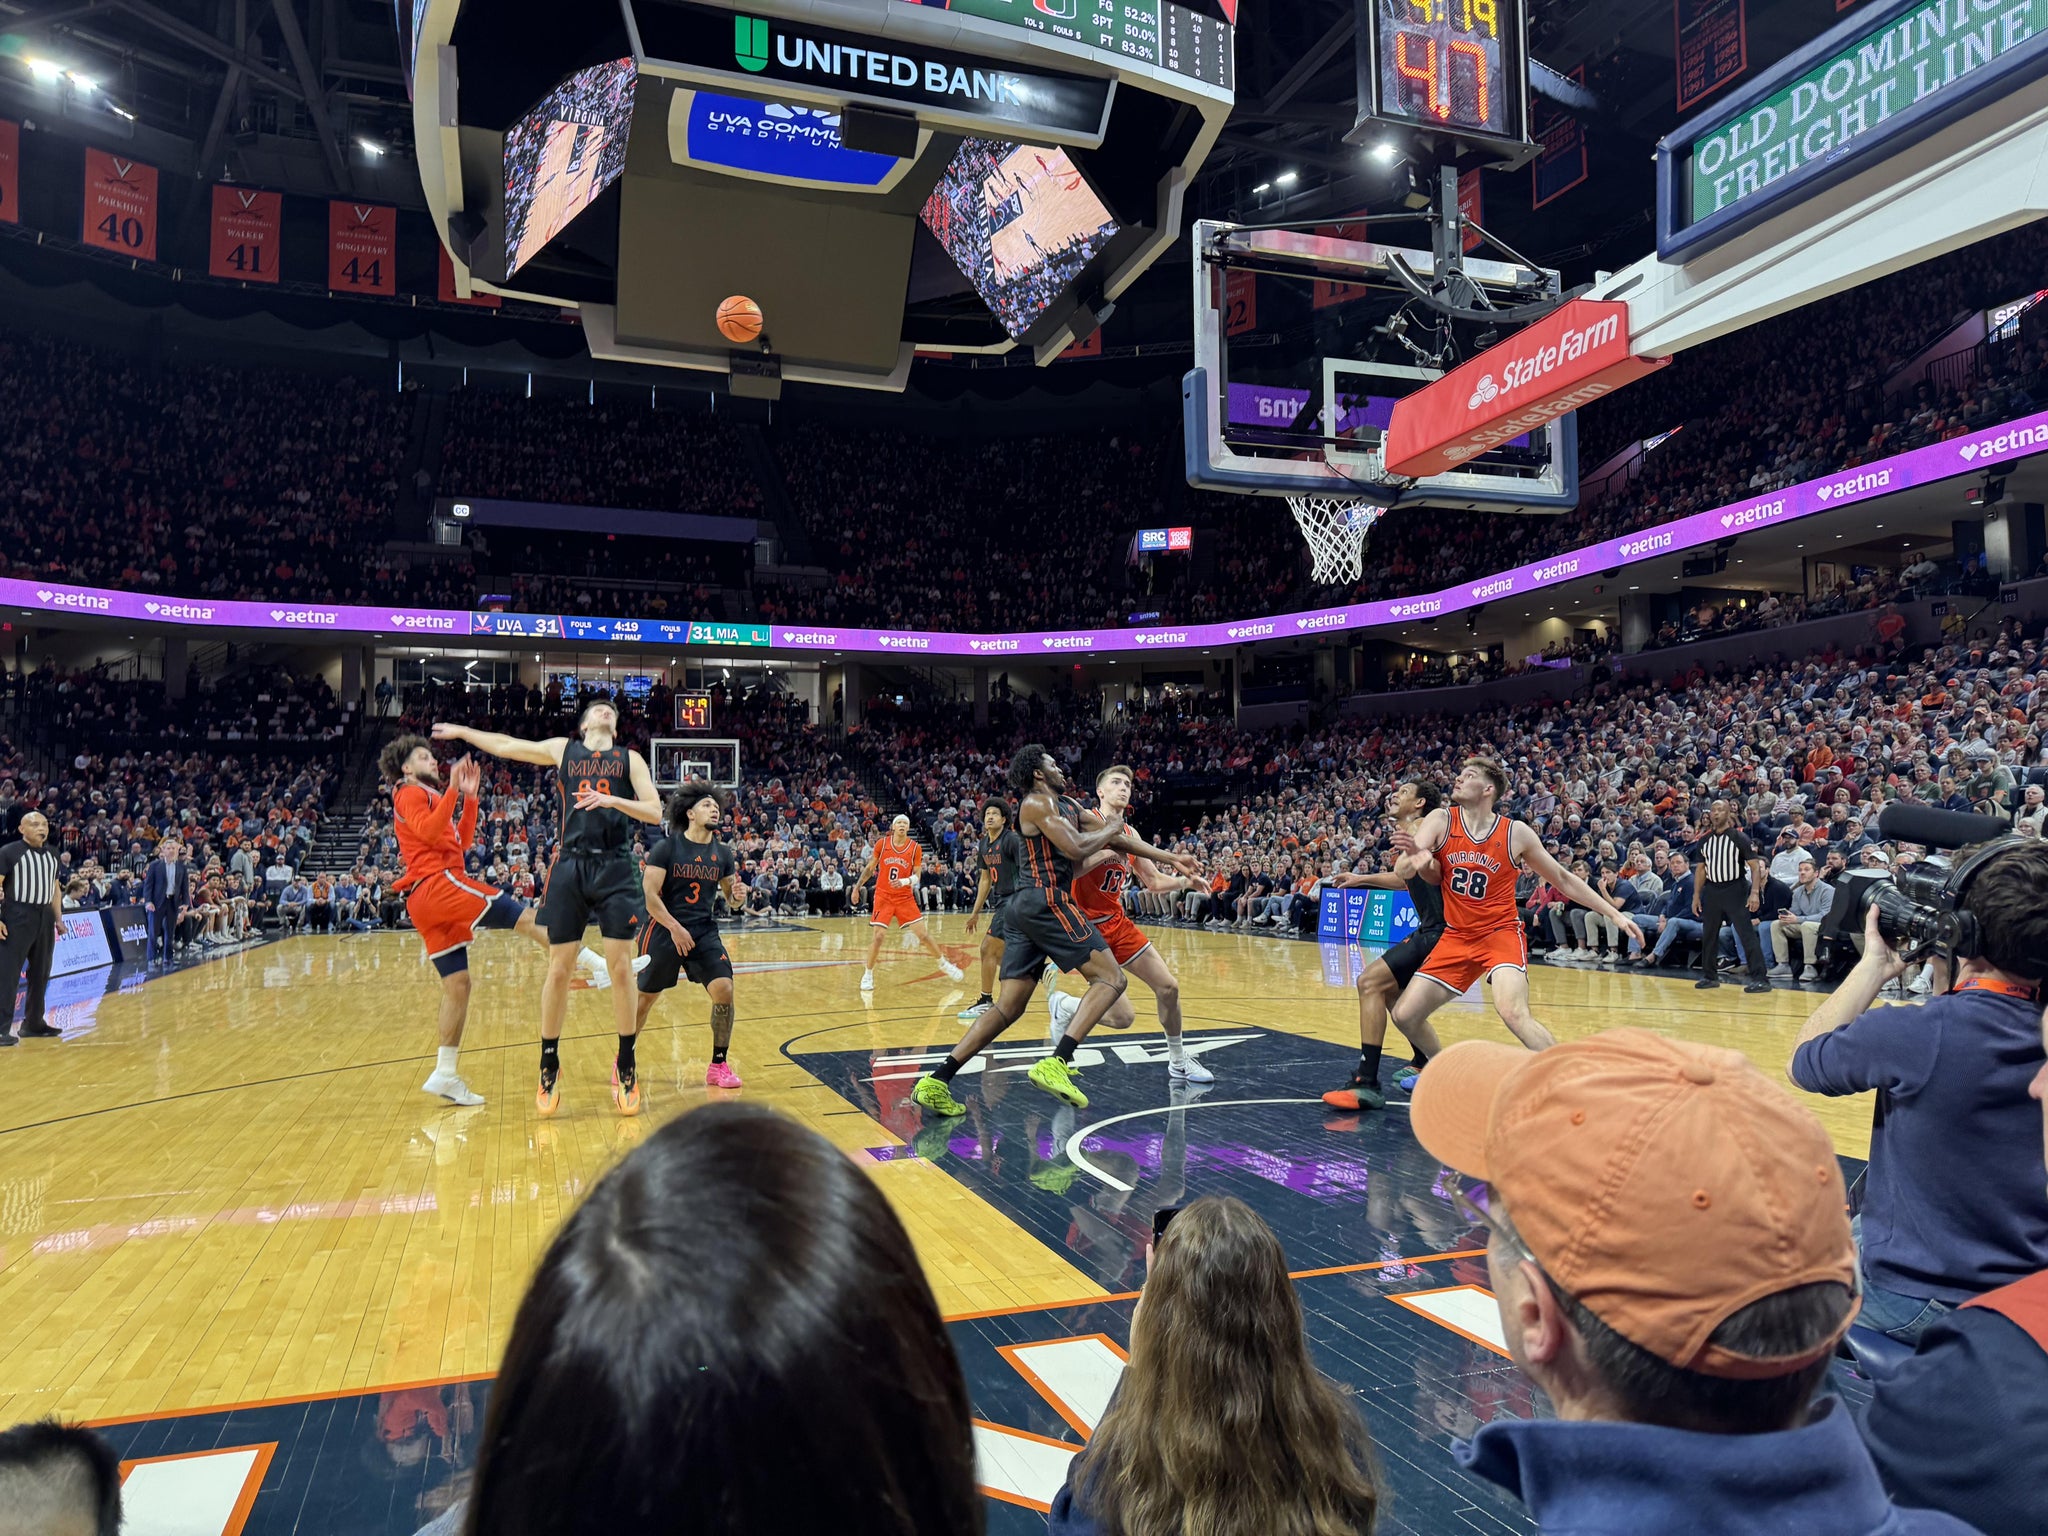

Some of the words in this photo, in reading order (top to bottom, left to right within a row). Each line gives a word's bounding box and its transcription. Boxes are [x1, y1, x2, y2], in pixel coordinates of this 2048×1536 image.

[1023, 17, 1037, 30] TOL
[1039, 21, 1044, 30] 3
[1124, 6, 1156, 26] 52.2%
[1170, 16, 1175, 25] 3
[1193, 24, 1201, 34] 10
[1191, 12, 1203, 24] PTS
[1052, 24, 1073, 37] FOULS
[1092, 14, 1113, 30] 3PT
[1125, 23, 1156, 43] 50.0%
[1100, 34, 1113, 47] FT
[1121, 40, 1153, 59] 83.3%
[1168, 49, 1178, 58] 10
[777, 35, 918, 86] UNITED
[925, 61, 1021, 106] BANK
[1168, 59, 1179, 69] 88
[1700, 107, 1777, 175] OLD
[1790, 0, 1999, 126] DOMINI
[560, 104, 604, 126] VIRGINIA
[1713, 79, 1896, 212] FREIGHT
[1913, 0, 2032, 103] LINE
[708, 124, 795, 142] CREDIT
[709, 111, 751, 127] UVA
[757, 119, 841, 141] COMMU
[98, 194, 143, 215] PARKHILL
[97, 213, 144, 248] 40
[227, 229, 264, 240] WALKER
[977, 191, 994, 279] VIRGINIA
[336, 242, 388, 255] SINGLETARY
[226, 243, 262, 273] 41
[341, 257, 383, 286] 44
[1979, 424, 2048, 458] aetna
[1833, 469, 1890, 498] aetna
[1734, 500, 1783, 526] aetna
[1142, 531, 1166, 542] SRC
[1631, 532, 1672, 555] aetna
[1543, 559, 1577, 580] aetna
[1481, 578, 1512, 597] aetna
[53, 592, 109, 610] aetna
[1402, 600, 1440, 616] aetna
[160, 603, 212, 619] aetna
[286, 610, 336, 624] aetna
[405, 615, 453, 629] aetna
[496, 619, 523, 631] UVA
[535, 619, 559, 634] 31
[614, 621, 639, 632] 4:19
[1307, 613, 1345, 628] aetna
[692, 626, 715, 640] 31
[716, 628, 739, 640] MIA
[795, 632, 835, 645] aetna
[1146, 632, 1186, 644] aetna
[1237, 623, 1273, 637] aetna
[891, 636, 929, 648] aetna
[980, 639, 1018, 650] aetna
[1053, 636, 1092, 648] aetna
[685, 698, 707, 708] 4:19
[568, 759, 624, 778] MIAMI
[1446, 852, 1501, 873] VIRGINIA
[674, 863, 720, 881] MIAMI
[889, 866, 899, 881] 6
[1100, 869, 1124, 892] 17
[1450, 866, 1489, 901] 28
[685, 882, 701, 904] 3
[1349, 895, 1363, 905] 4:19
[1327, 902, 1338, 913] 31
[1373, 904, 1384, 916] 31
